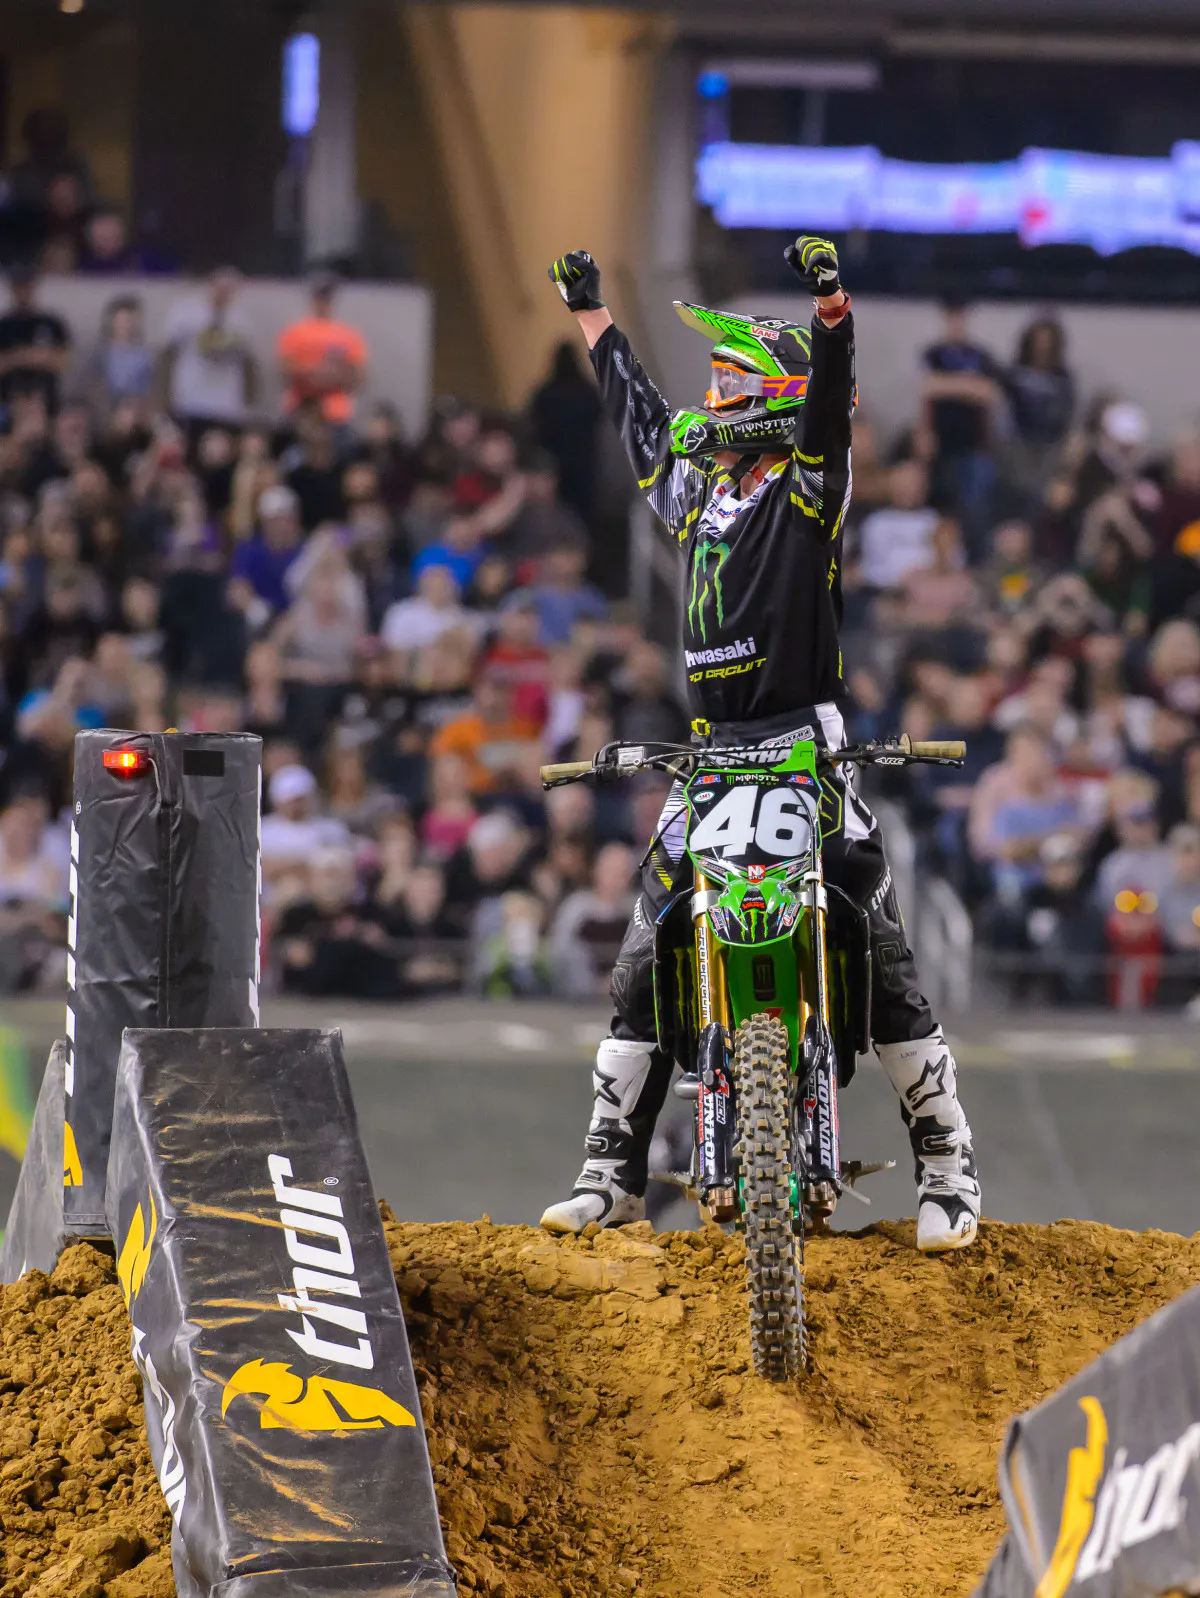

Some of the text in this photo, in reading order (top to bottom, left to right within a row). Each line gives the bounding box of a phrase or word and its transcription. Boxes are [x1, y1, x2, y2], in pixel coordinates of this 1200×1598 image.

[751, 326, 778, 340] VANS
[734, 417, 796, 434] MONSTER
[744, 428, 789, 438] ENERGY
[875, 757, 905, 765] ARC
[735, 774, 779, 782] MONSTE
[690, 785, 817, 857] 46
[872, 866, 892, 911] thor
[817, 1069, 831, 1169] DUNLOP
[268, 1154, 374, 1369] thor
